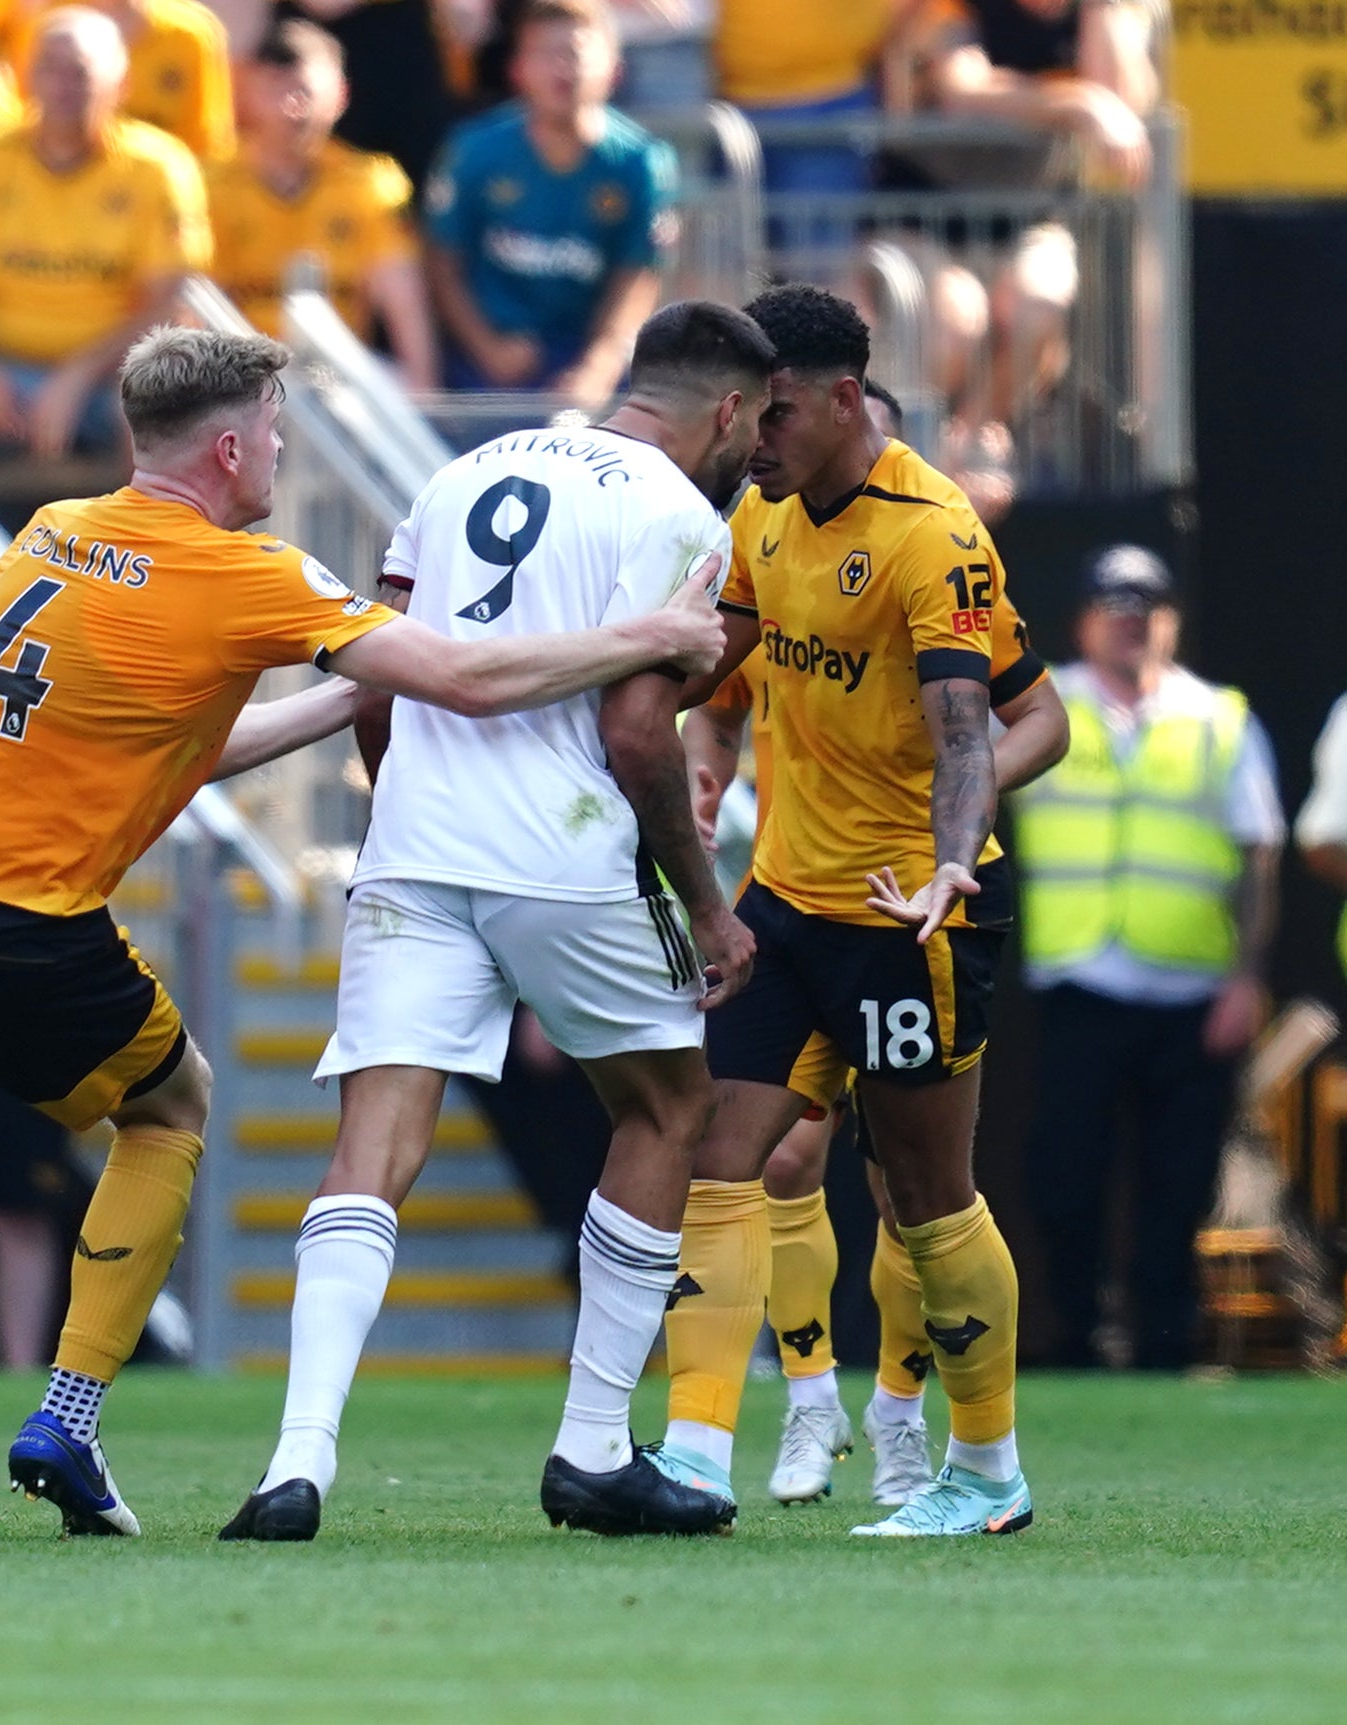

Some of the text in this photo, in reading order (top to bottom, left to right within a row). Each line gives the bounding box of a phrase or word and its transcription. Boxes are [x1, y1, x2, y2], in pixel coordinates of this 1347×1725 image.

[21, 525, 154, 588] COLLINS
[454, 475, 551, 624] 9
[945, 563, 993, 610] 12
[764, 627, 871, 695] stroPay
[859, 998, 934, 1070] 18
